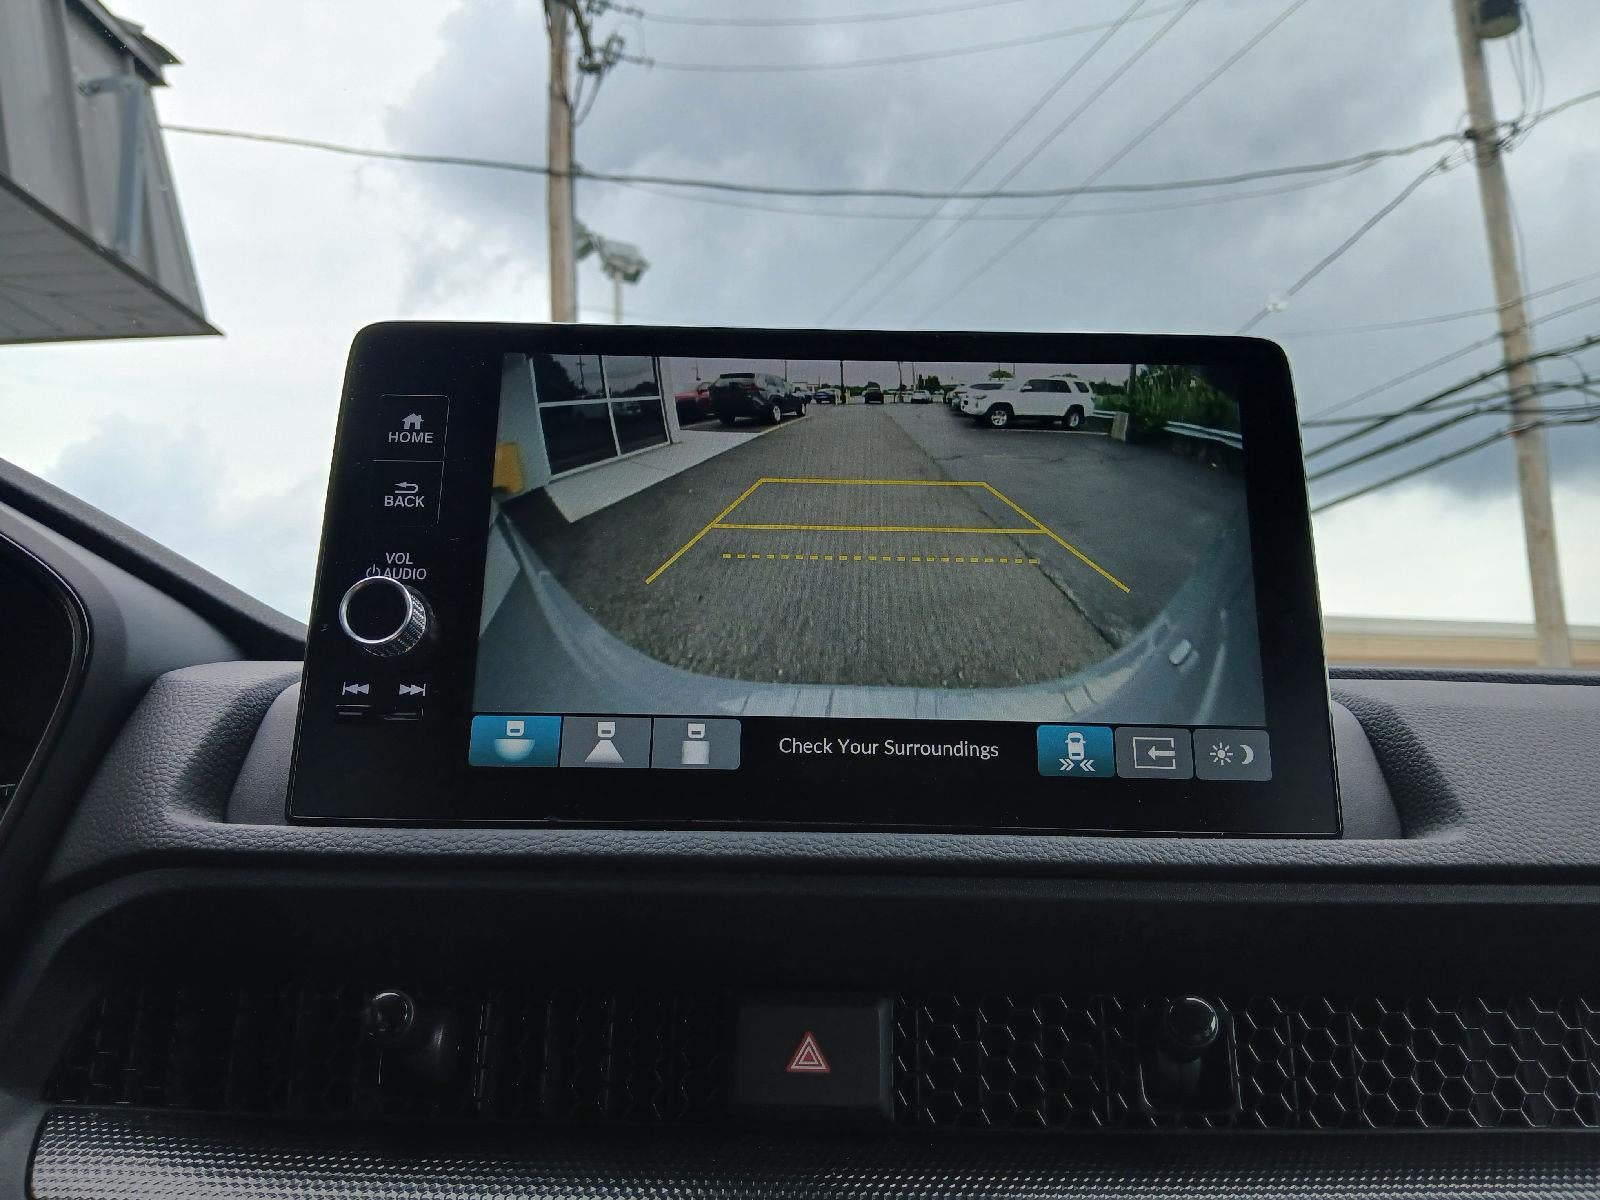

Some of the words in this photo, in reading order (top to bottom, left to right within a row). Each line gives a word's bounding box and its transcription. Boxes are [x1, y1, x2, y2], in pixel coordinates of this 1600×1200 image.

[388, 431, 434, 443] HOME
[384, 495, 425, 507] BACK
[385, 552, 413, 564] VOL
[383, 567, 427, 580] AUDIO
[779, 737, 833, 754] Check
[837, 738, 879, 755] Your
[884, 739, 999, 760] Surroundings
